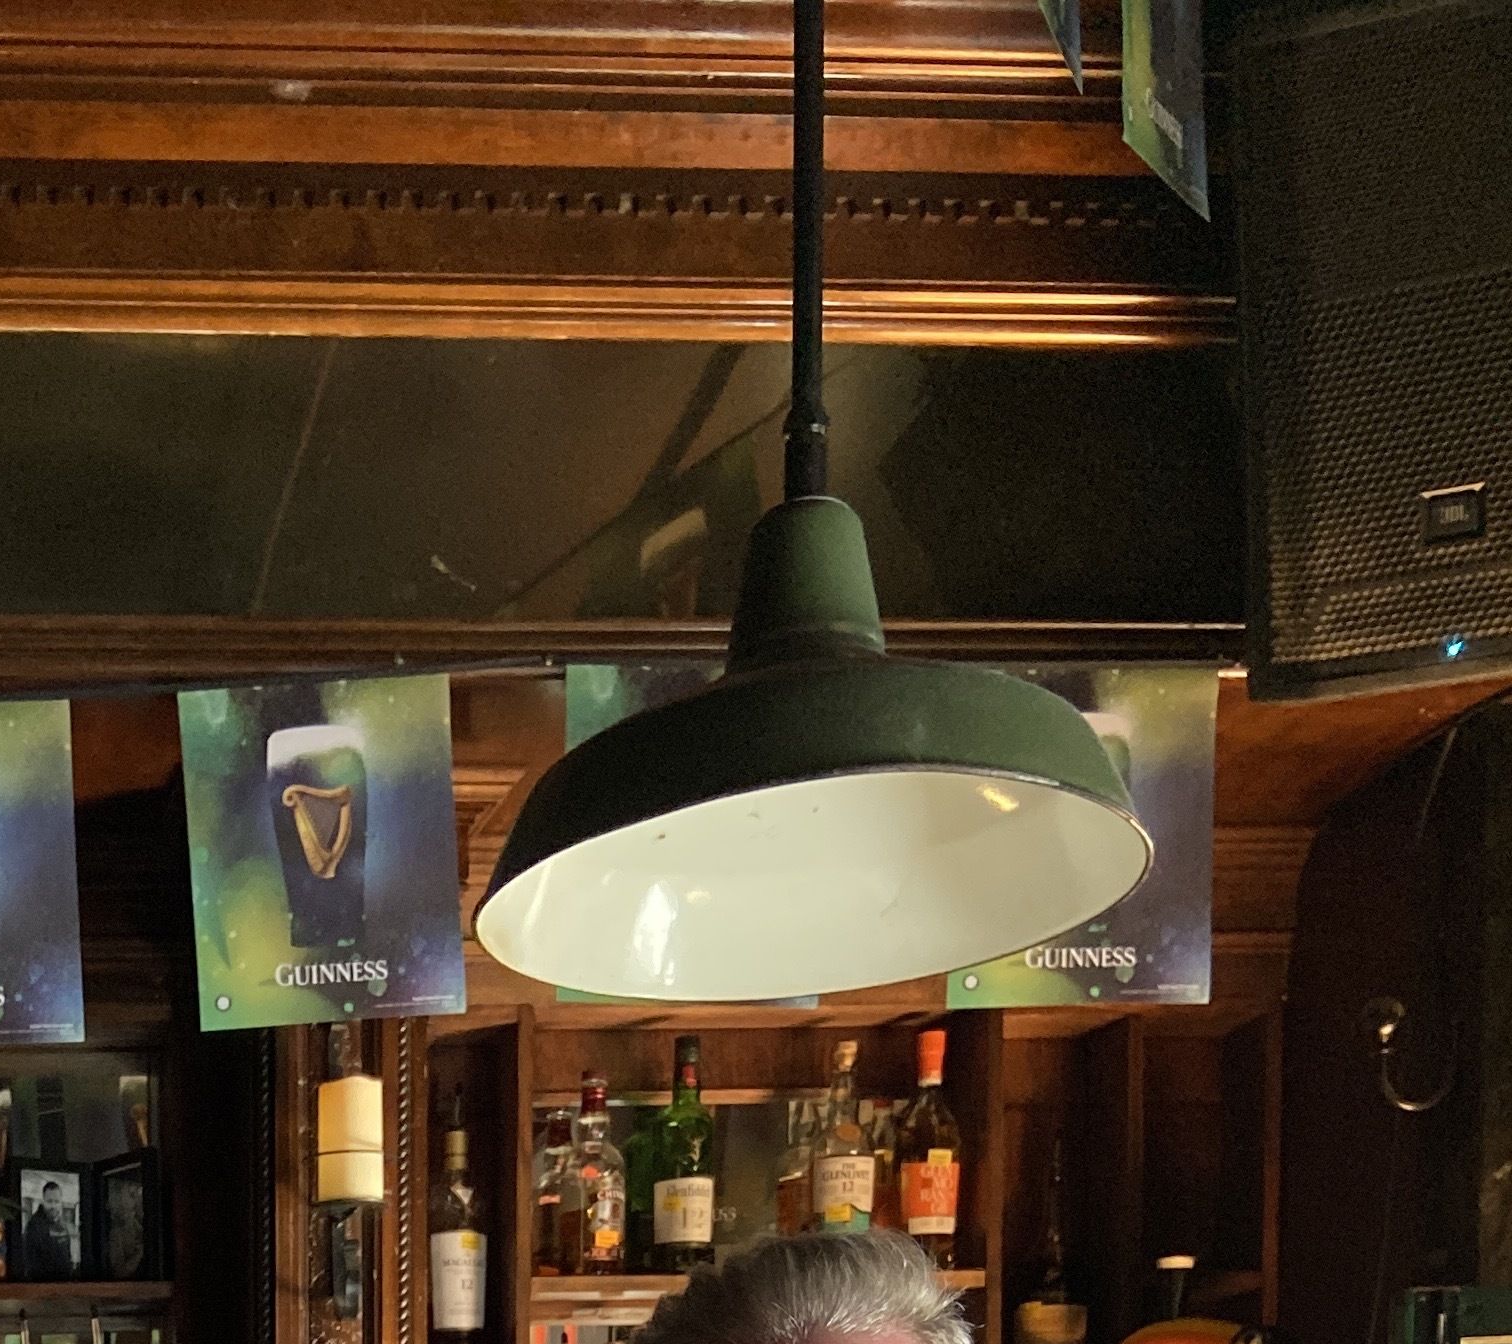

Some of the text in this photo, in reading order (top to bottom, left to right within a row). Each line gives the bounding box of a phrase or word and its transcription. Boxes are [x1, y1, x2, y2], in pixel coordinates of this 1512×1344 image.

[1025, 945, 1137, 970] GUINNESS
[275, 960, 388, 986] GUINNESS
[682, 1207, 704, 1229] 12
